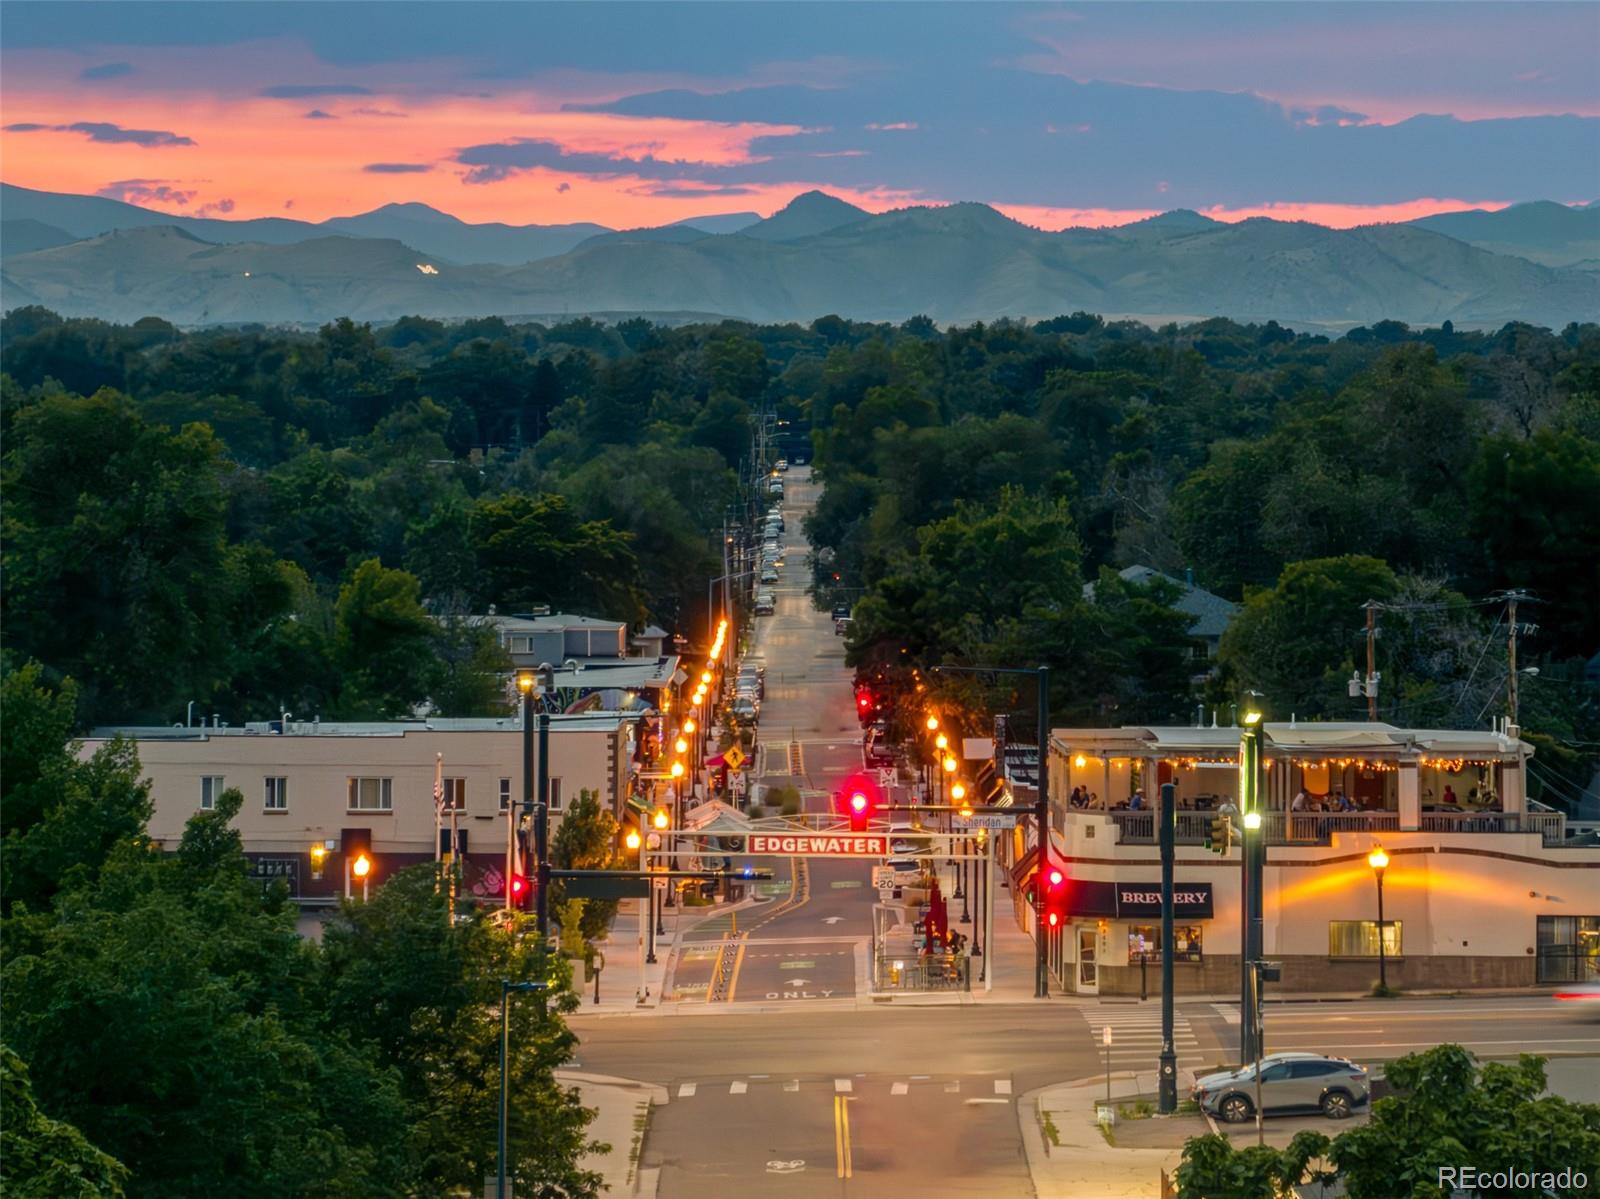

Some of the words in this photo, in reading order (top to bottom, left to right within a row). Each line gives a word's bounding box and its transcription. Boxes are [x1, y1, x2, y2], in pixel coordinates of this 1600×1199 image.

[753, 837, 881, 853] EDGEWATER
[879, 880, 894, 889] 20
[765, 990, 833, 1000] ONLY
